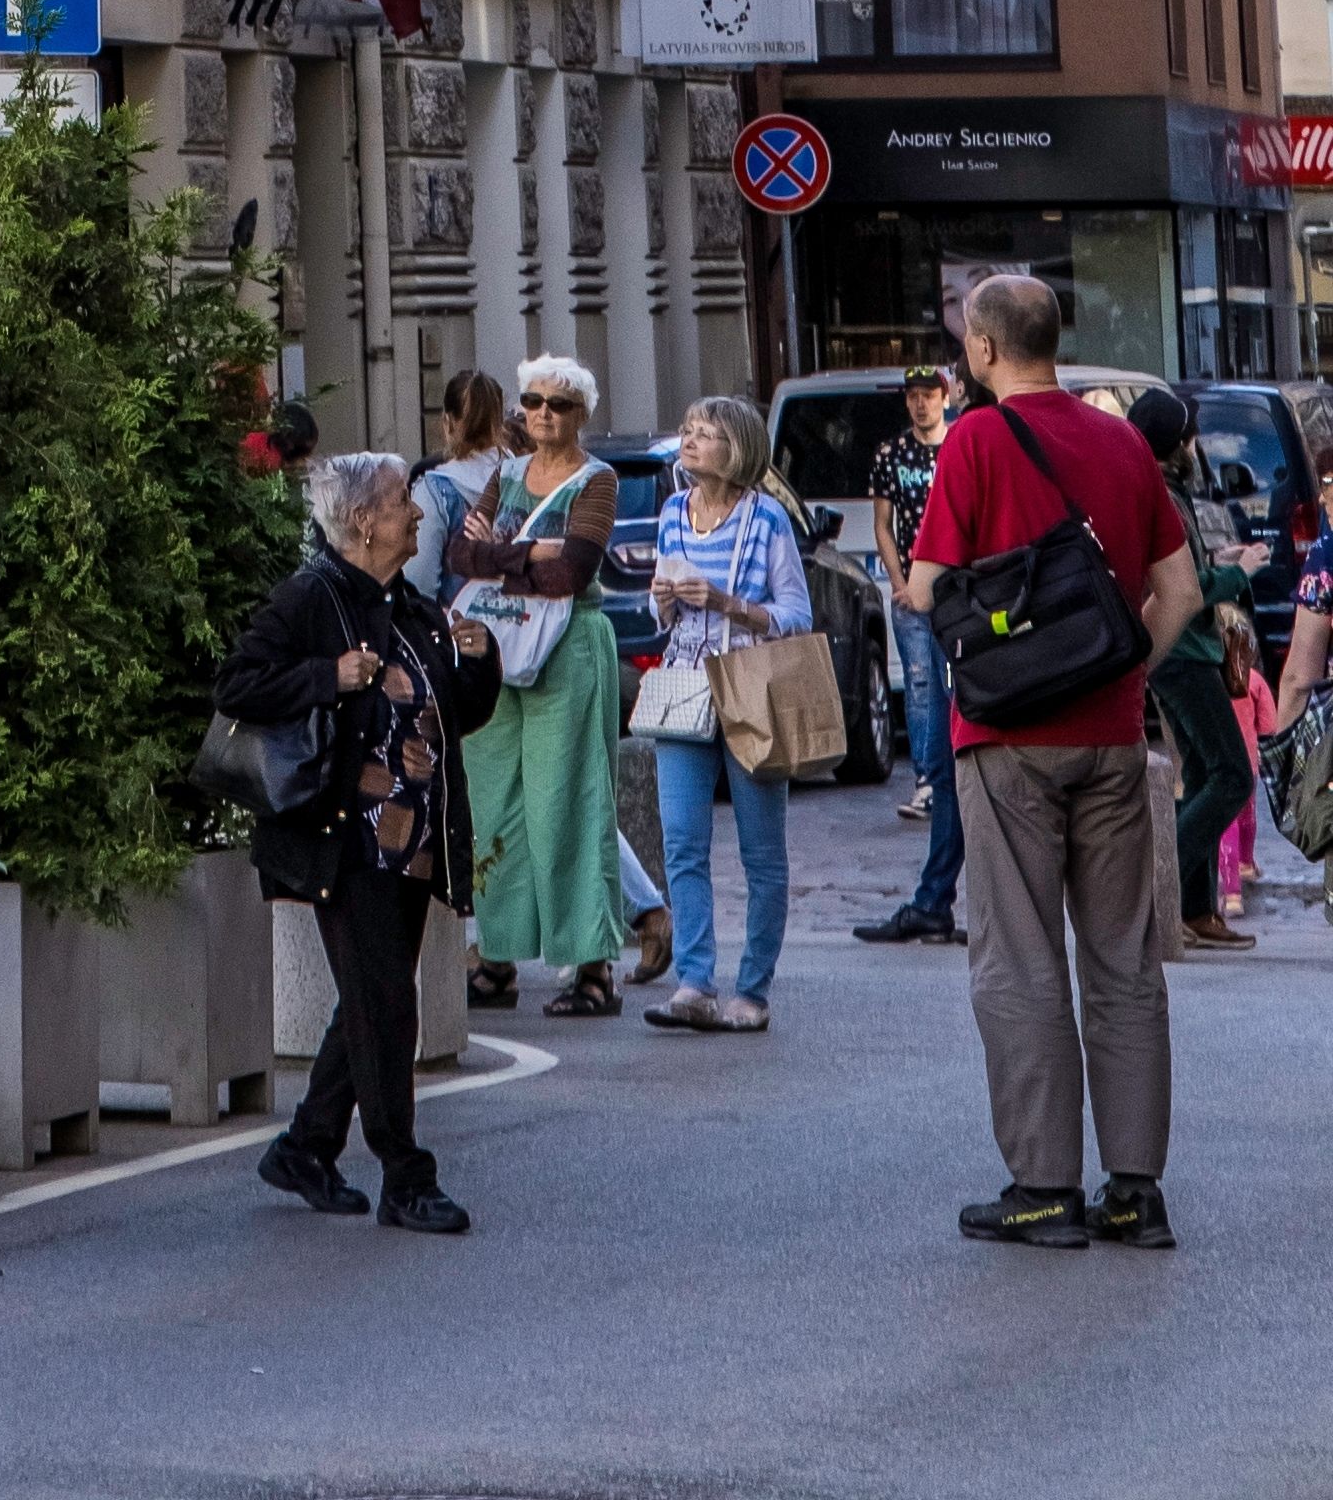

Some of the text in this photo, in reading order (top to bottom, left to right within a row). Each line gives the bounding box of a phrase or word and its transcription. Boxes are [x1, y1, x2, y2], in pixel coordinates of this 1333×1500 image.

[649, 40, 807, 56] LATVIJAS PROVES BIROJS
[887, 127, 1052, 148] ANDREY SILCHENKO
[967, 159, 1000, 171] SALON
